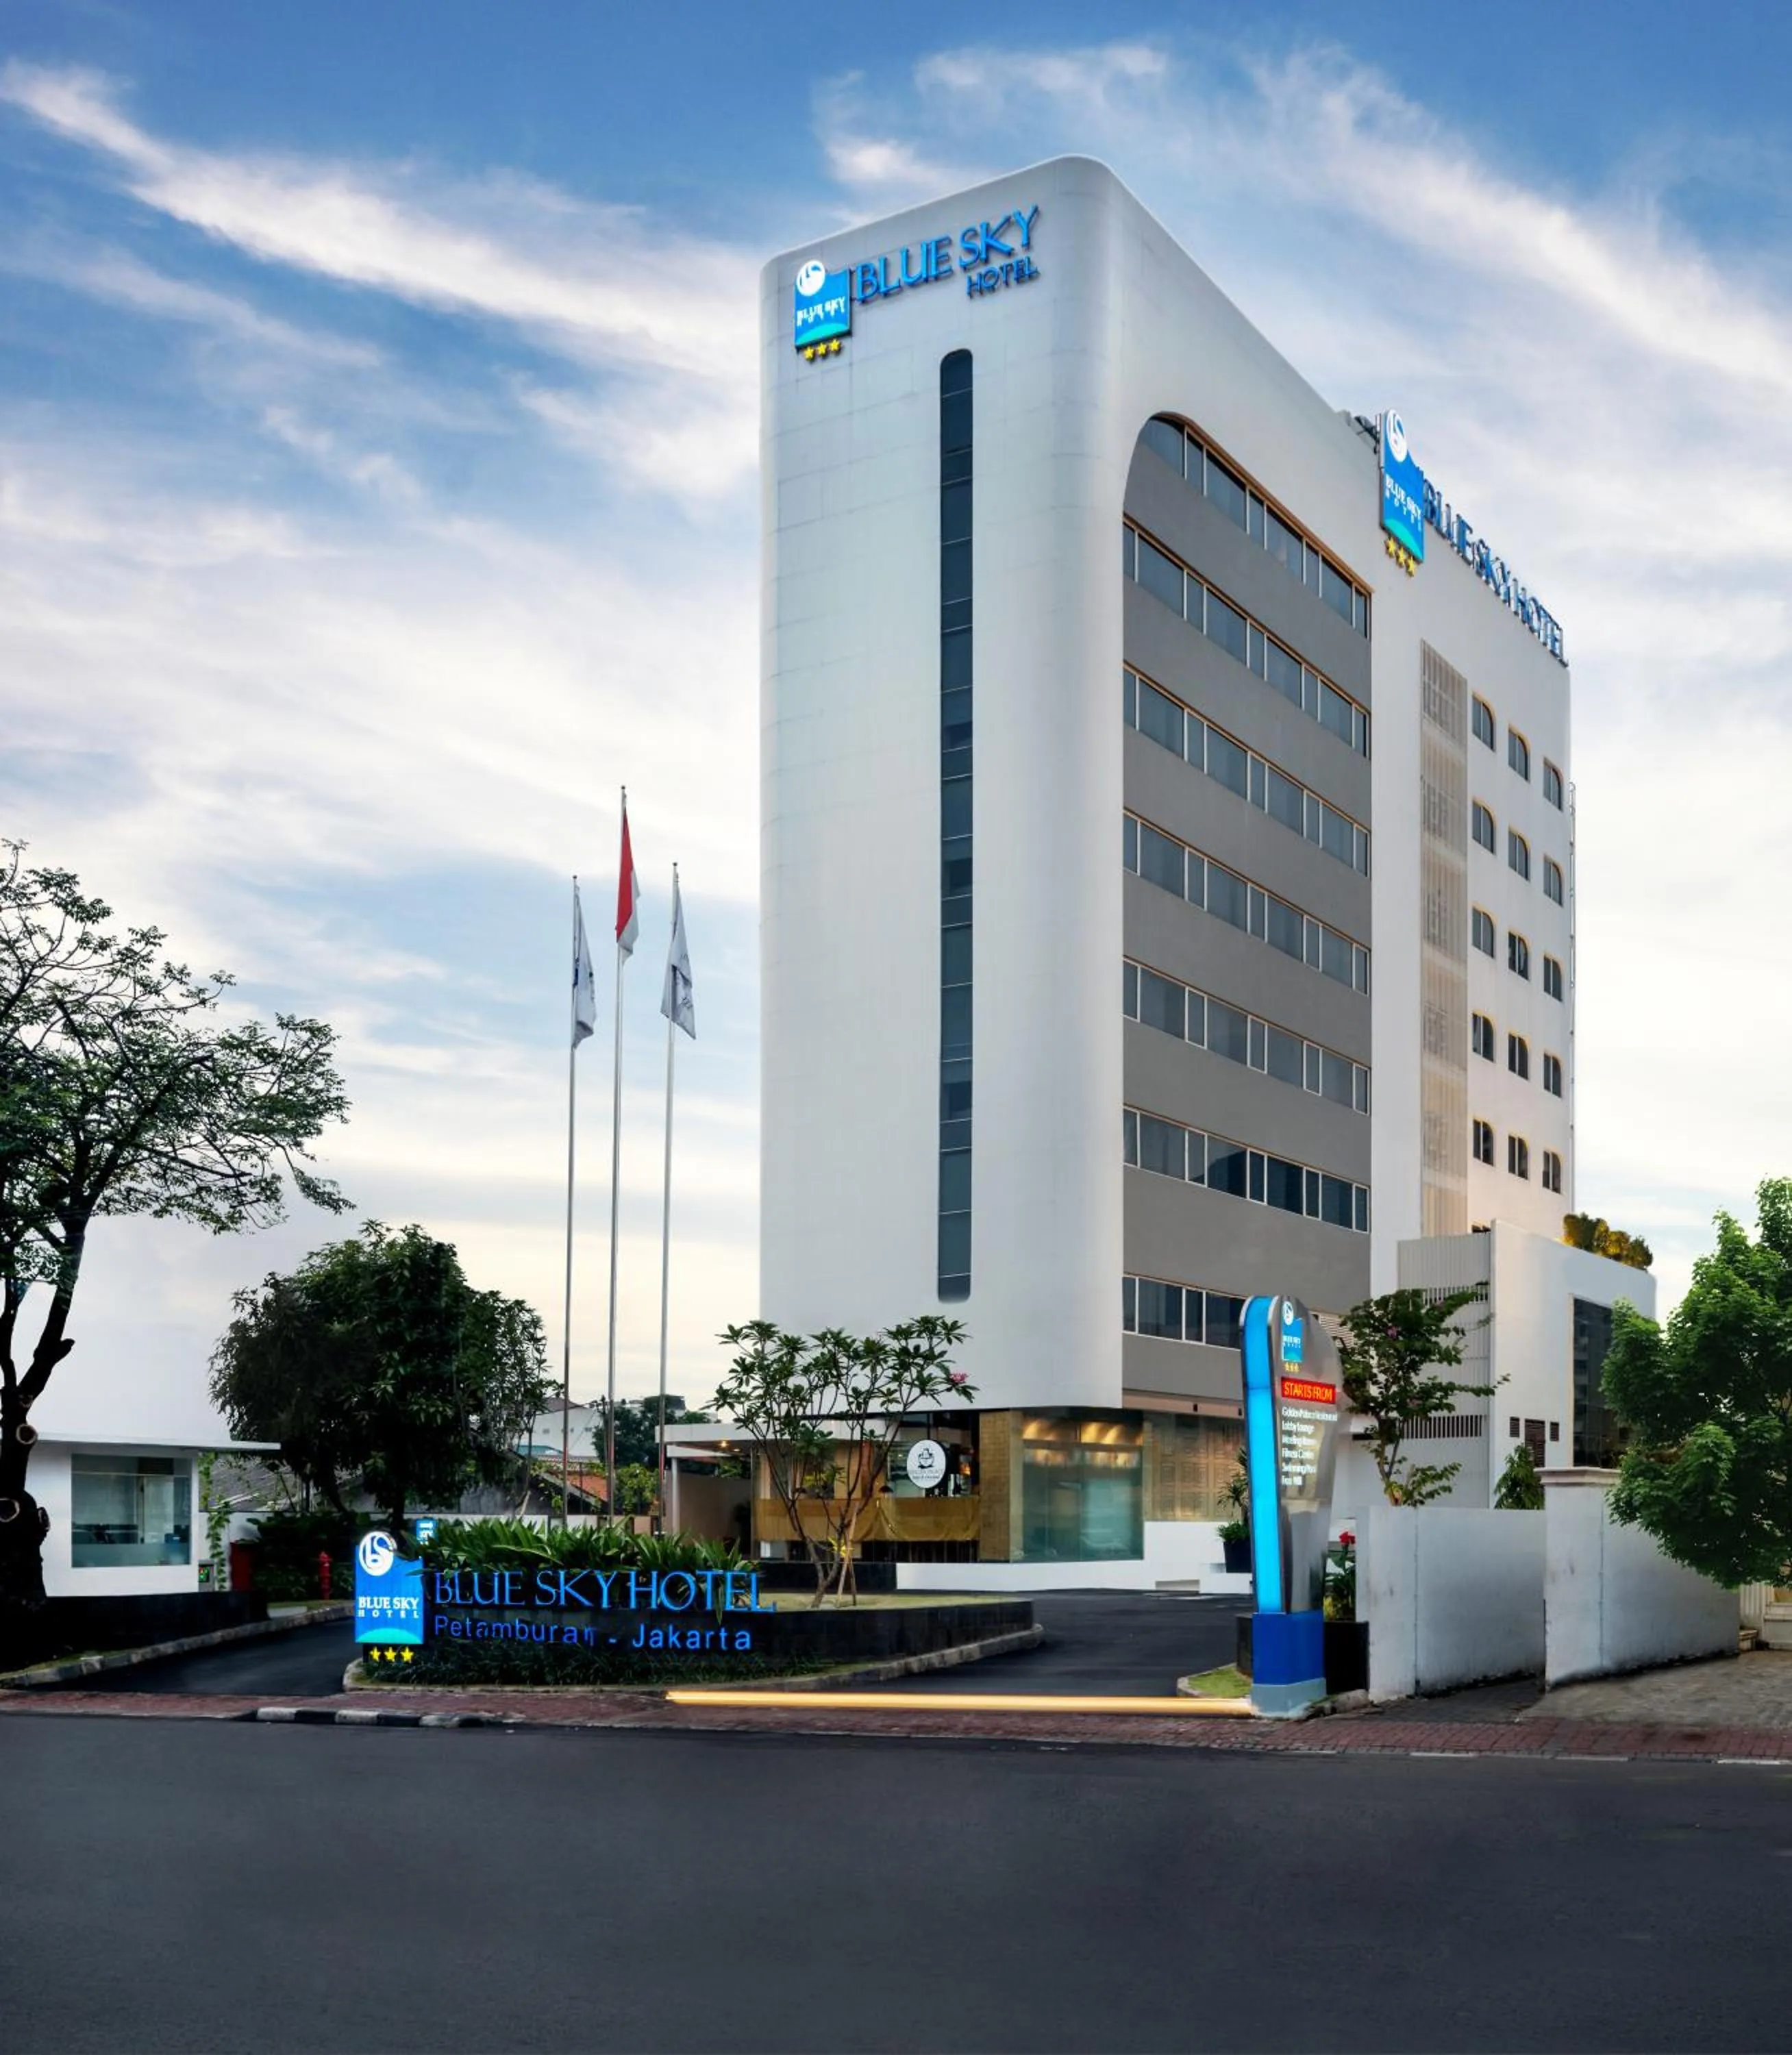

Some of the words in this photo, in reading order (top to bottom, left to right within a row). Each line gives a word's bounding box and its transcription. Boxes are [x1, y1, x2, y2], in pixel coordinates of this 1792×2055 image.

[855, 235, 954, 303] BLUE
[959, 203, 1041, 271] SKY
[966, 256, 1041, 297] HOTEL
[1385, 473, 1406, 505] BLUE
[1284, 1381, 1312, 1399] STARTS
[1312, 1385, 1332, 1402] FROM
[358, 1595, 390, 1609] BLUE
[393, 1596, 419, 1610] SKY
[434, 1569, 525, 1606] BLUE
[535, 1569, 618, 1609] SKY
[628, 1569, 777, 1612] HOTEL
[358, 1609, 419, 1619] HOTEL
[632, 1622, 752, 1651] Jakarta
